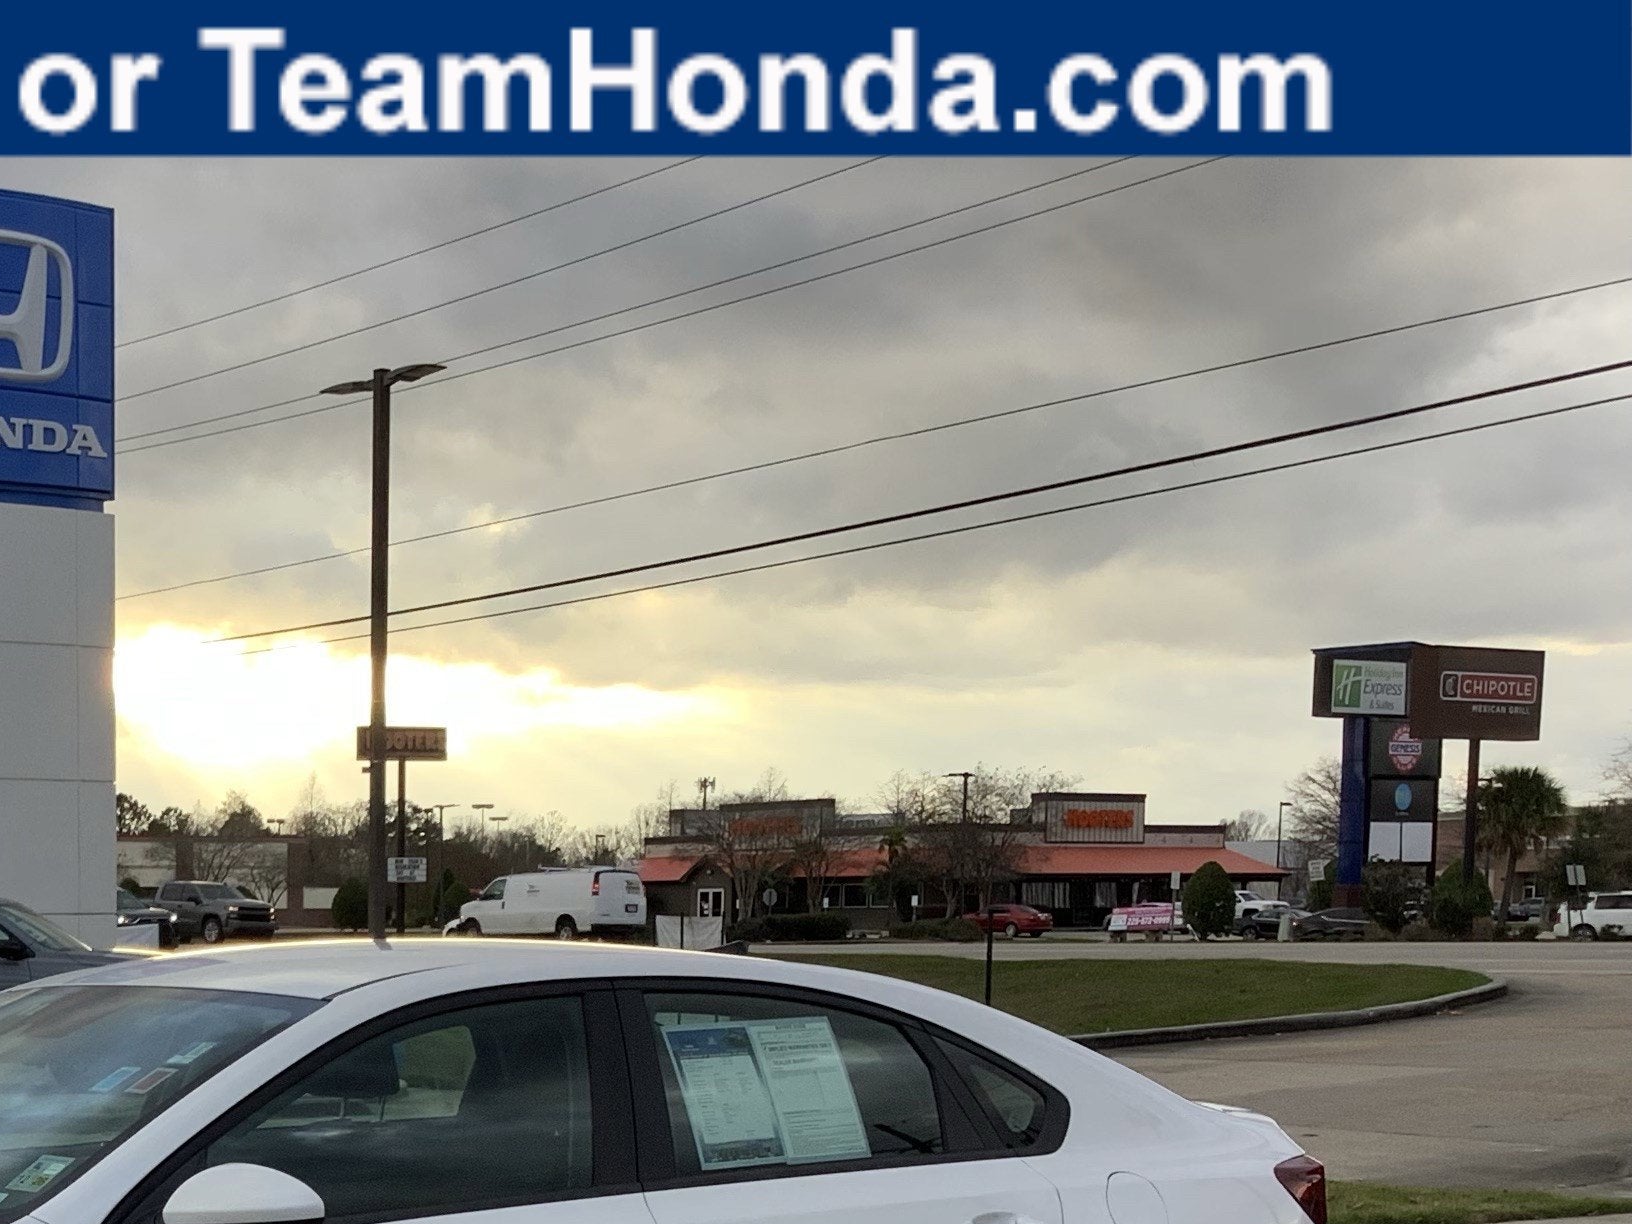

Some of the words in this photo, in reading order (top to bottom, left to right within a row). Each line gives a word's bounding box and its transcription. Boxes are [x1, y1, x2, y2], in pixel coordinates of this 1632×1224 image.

[1363, 679, 1403, 699] Express
[1463, 680, 1532, 696] CHIPOTLE
[1472, 704, 1506, 714] MEXICAN
[1508, 706, 1531, 715] GRILL
[365, 730, 443, 751] OOTERS
